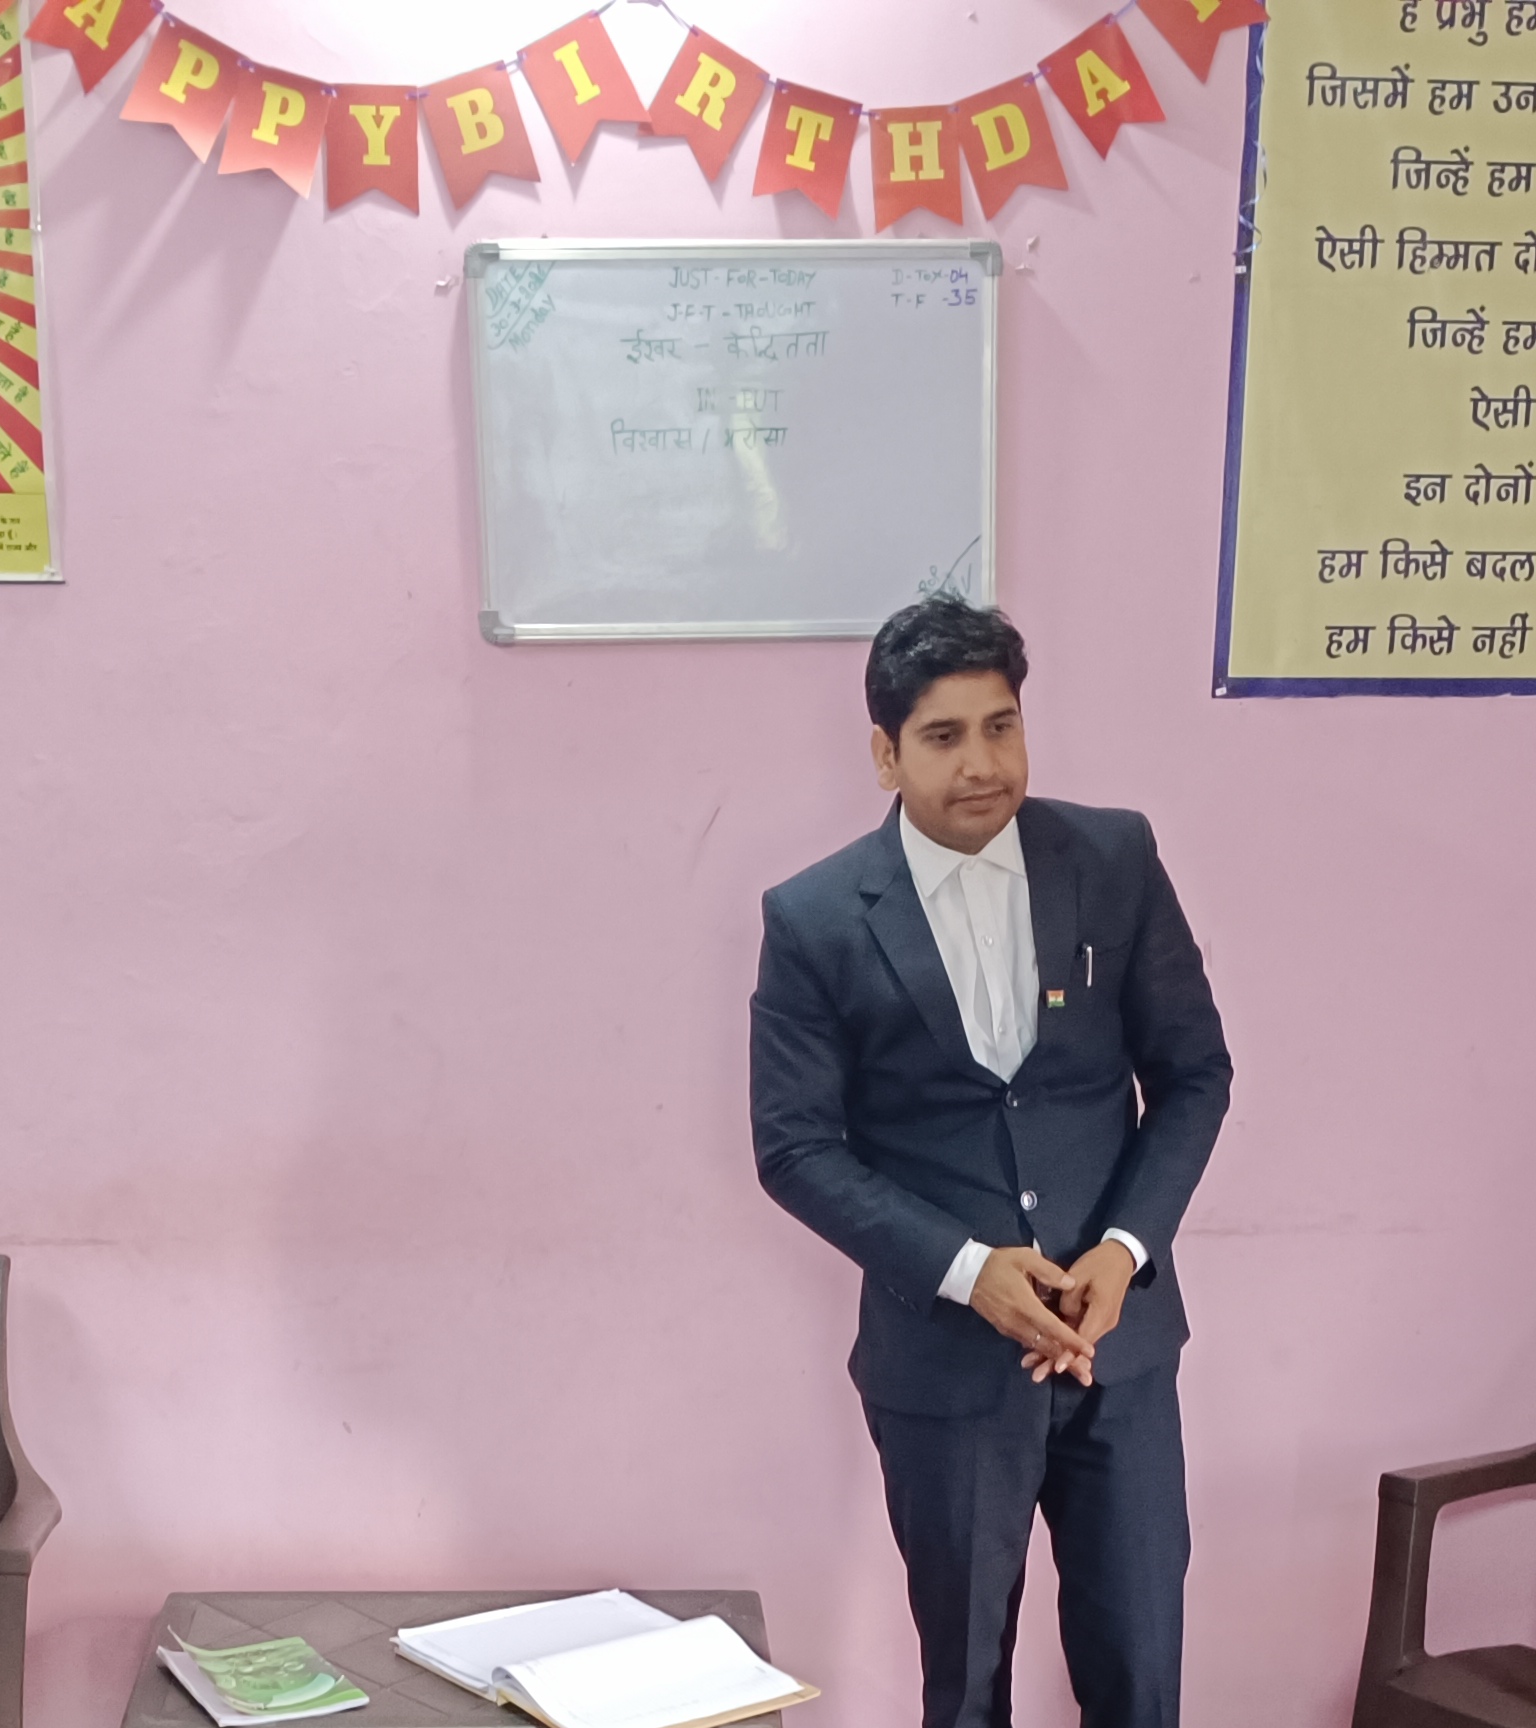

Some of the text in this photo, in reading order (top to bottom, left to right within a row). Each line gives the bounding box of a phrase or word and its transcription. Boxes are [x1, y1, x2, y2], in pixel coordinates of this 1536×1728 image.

[1306, 62, 1415, 109] जिसमें
[1427, 79, 1480, 116] हम
[1390, 145, 1474, 196] जिन्हें
[1315, 224, 1385, 272] ऐसी
[1396, 226, 1503, 275] हिम्मत
[1407, 305, 1490, 355] जिन्हें
[1403, 474, 1453, 506] इन
[1317, 550, 1369, 583] हम
[1380, 538, 1454, 581] किसे
[1325, 626, 1376, 659] हम
[1387, 614, 1461, 656] किसे
[1472, 612, 1533, 659] नहीं
